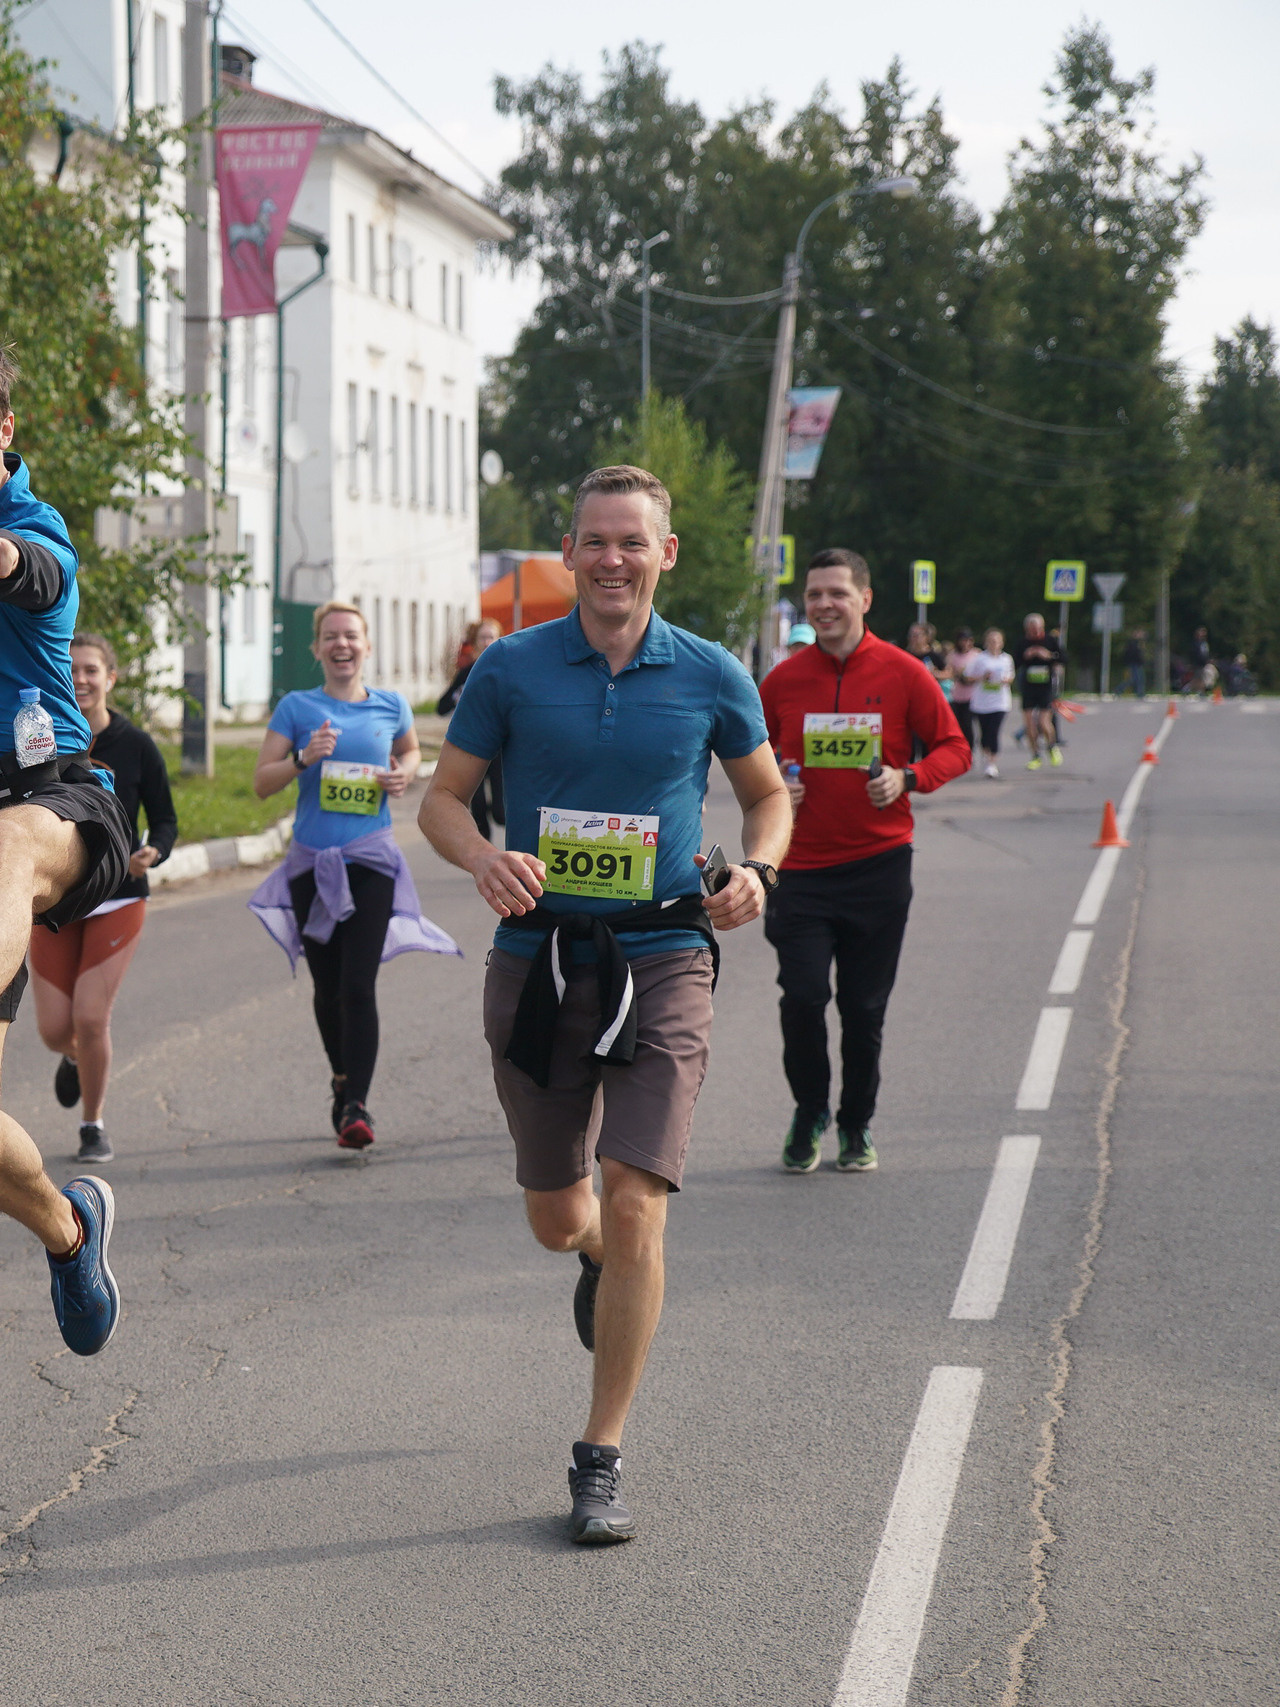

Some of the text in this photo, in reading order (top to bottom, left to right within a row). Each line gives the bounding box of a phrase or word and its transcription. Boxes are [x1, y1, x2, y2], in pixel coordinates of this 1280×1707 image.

[812, 740, 867, 756] 3457
[326, 785, 376, 804] 3082
[645, 833, 656, 843] A
[549, 848, 632, 880] 3091
[565, 878, 588, 886] АНДРЕЙ
